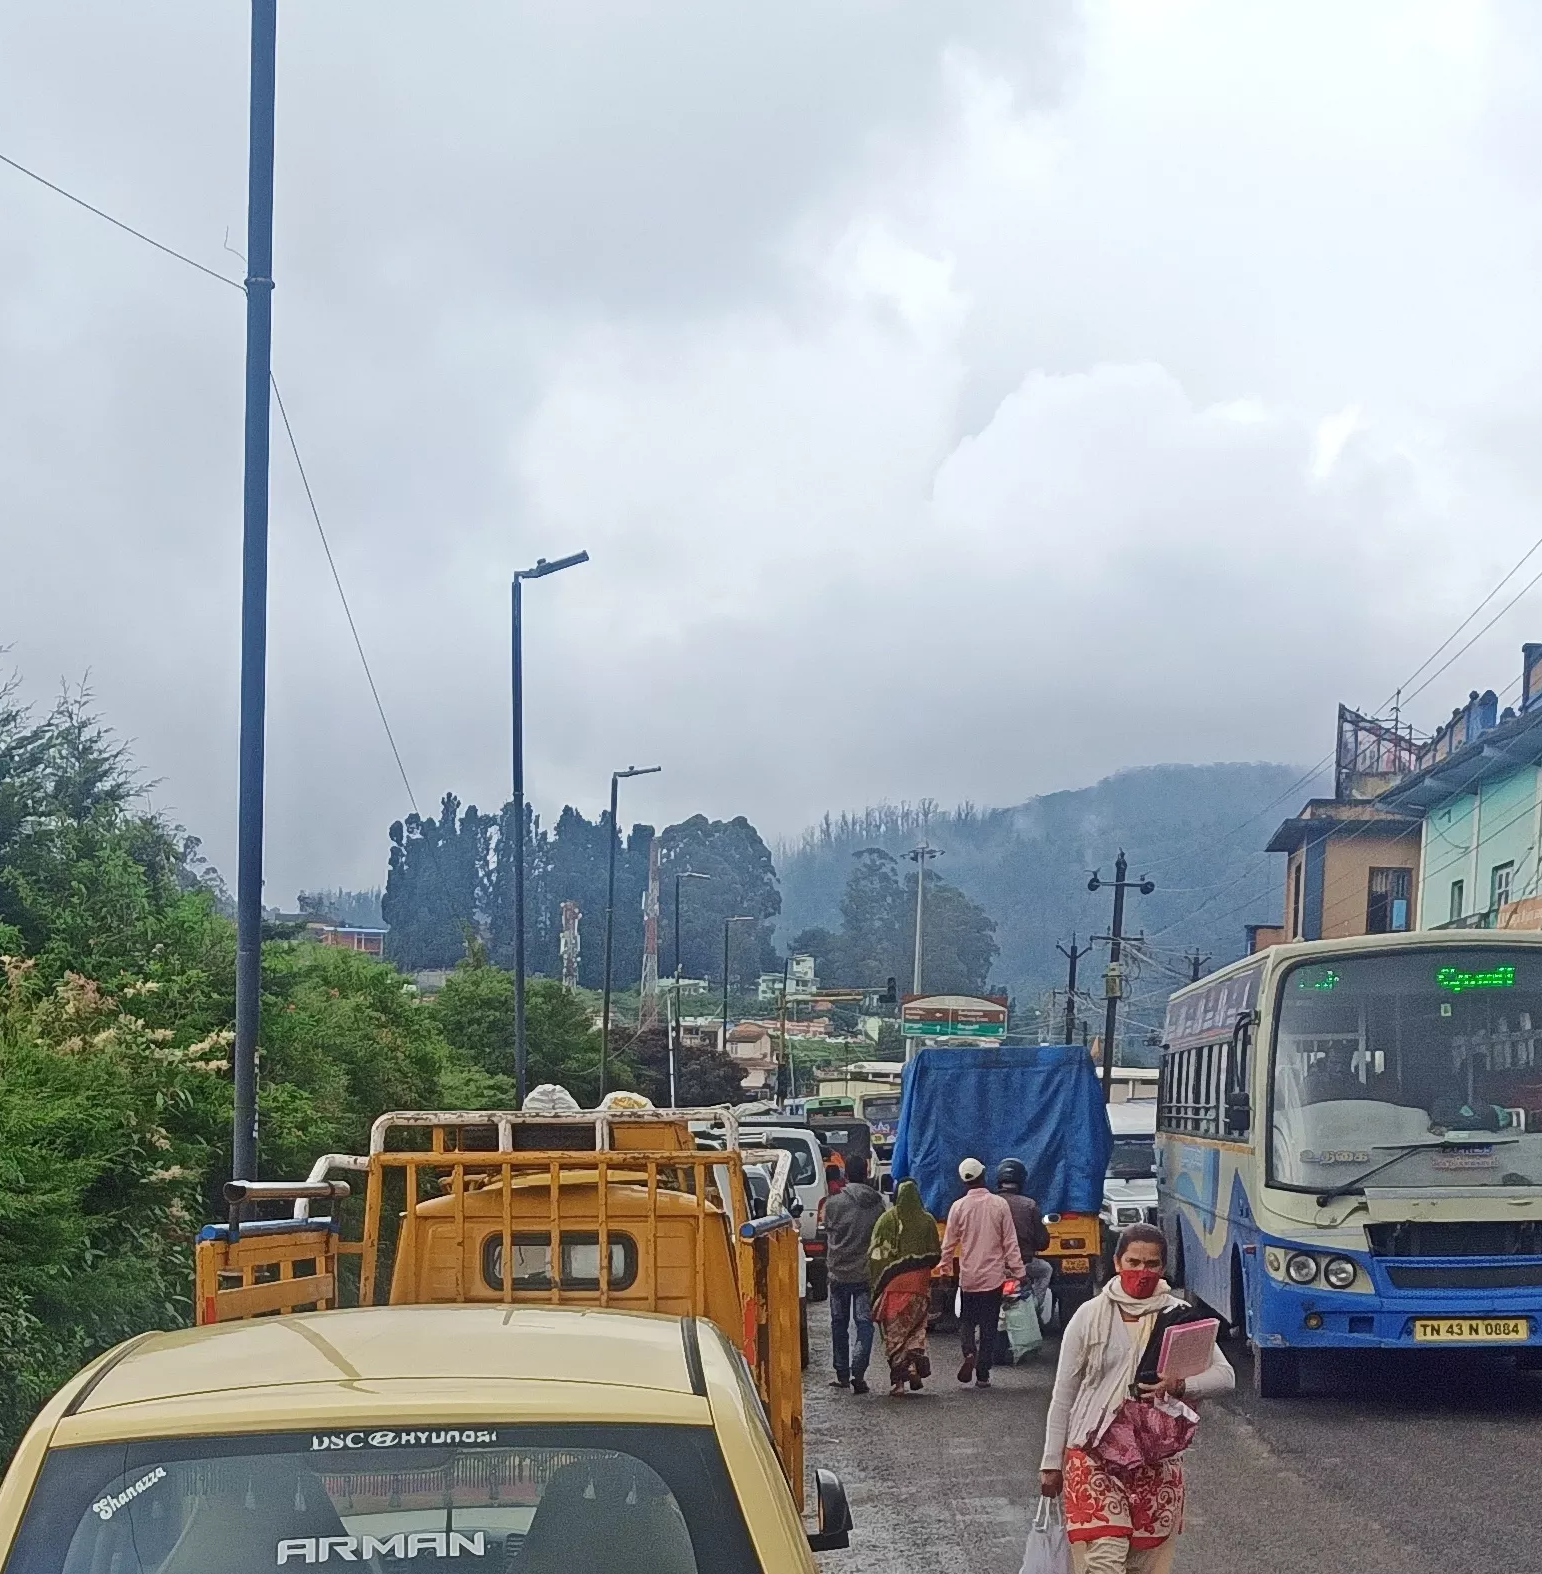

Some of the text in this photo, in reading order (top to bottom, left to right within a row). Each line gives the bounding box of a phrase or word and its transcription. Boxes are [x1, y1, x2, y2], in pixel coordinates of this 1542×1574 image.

[1420, 1324, 1440, 1336] TN
[1446, 1324, 1463, 1335] 43
[1469, 1323, 1479, 1335] N
[92, 1466, 167, 1520] Shanazza
[276, 1530, 486, 1566] ARMAN
